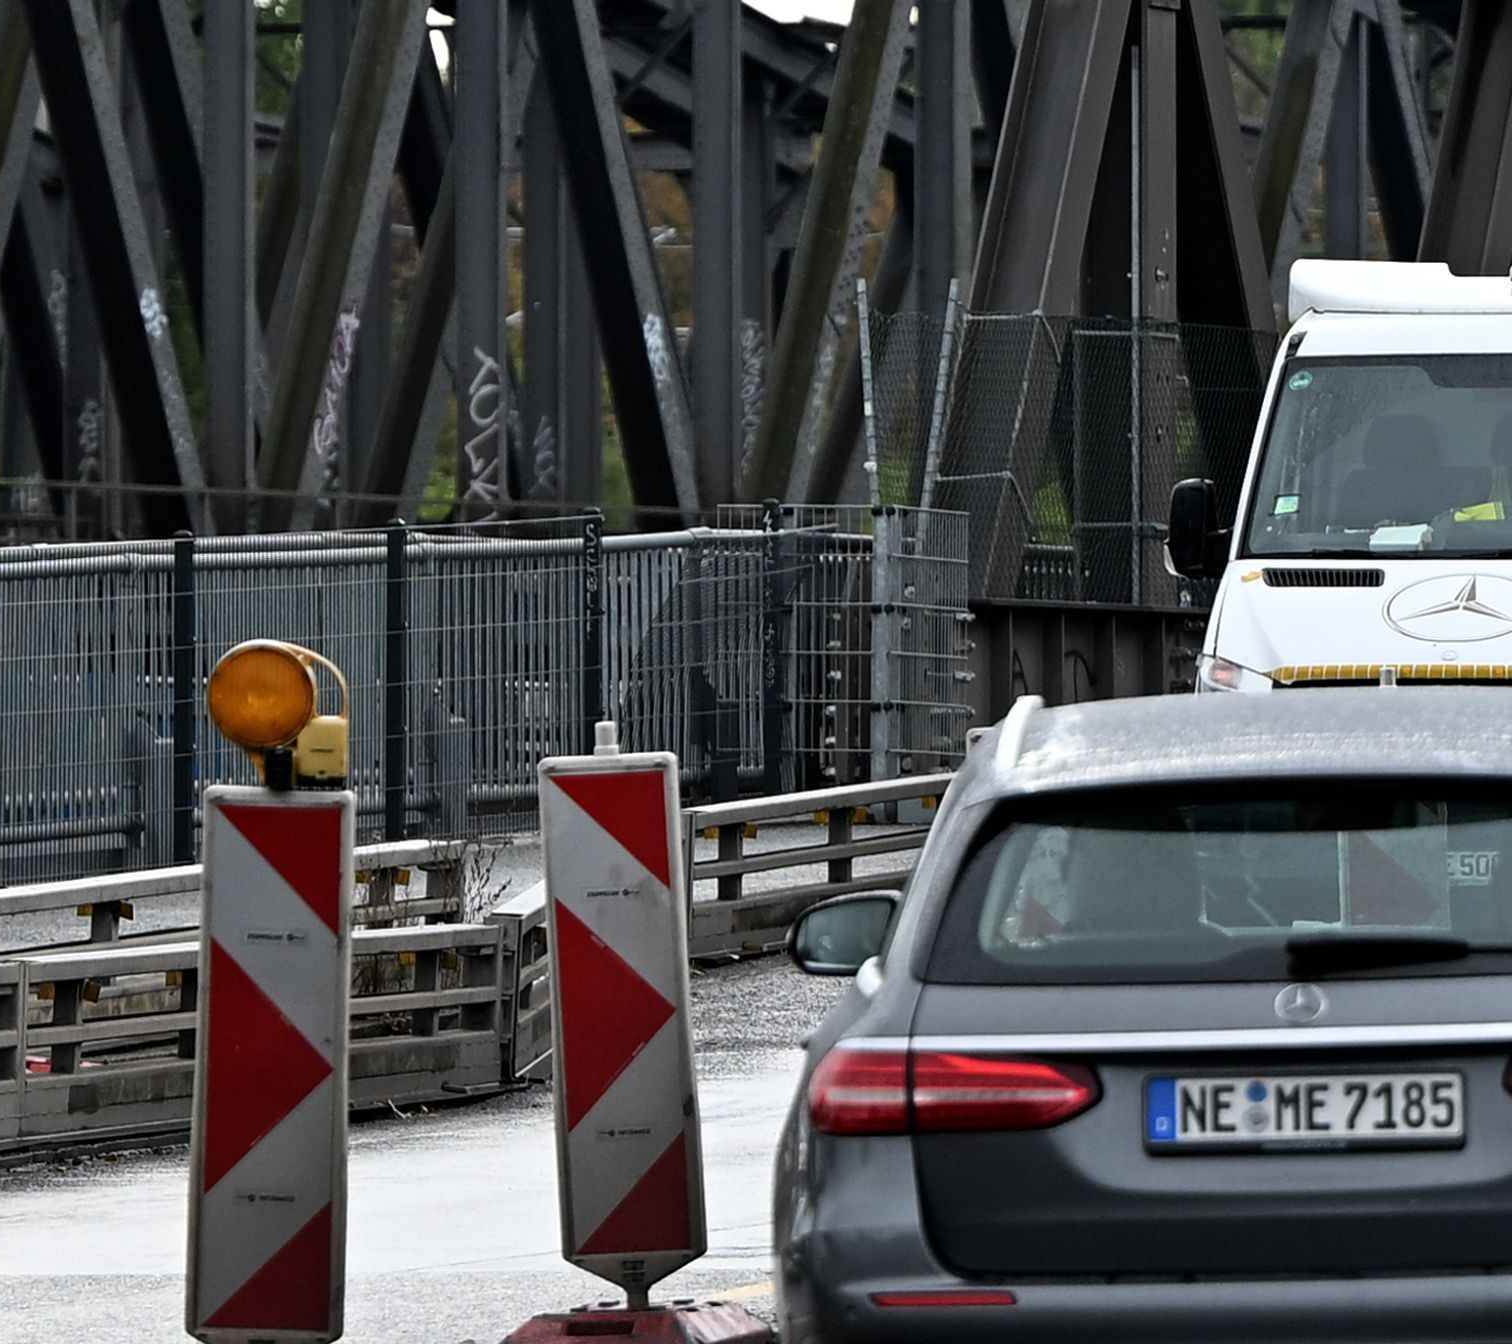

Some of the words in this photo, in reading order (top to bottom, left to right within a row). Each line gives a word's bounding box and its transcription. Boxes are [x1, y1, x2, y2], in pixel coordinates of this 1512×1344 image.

[1155, 1116, 1168, 1131] D
[1179, 1083, 1237, 1133] NE
[1275, 1082, 1331, 1131] ME
[1342, 1080, 1456, 1130] 7185
